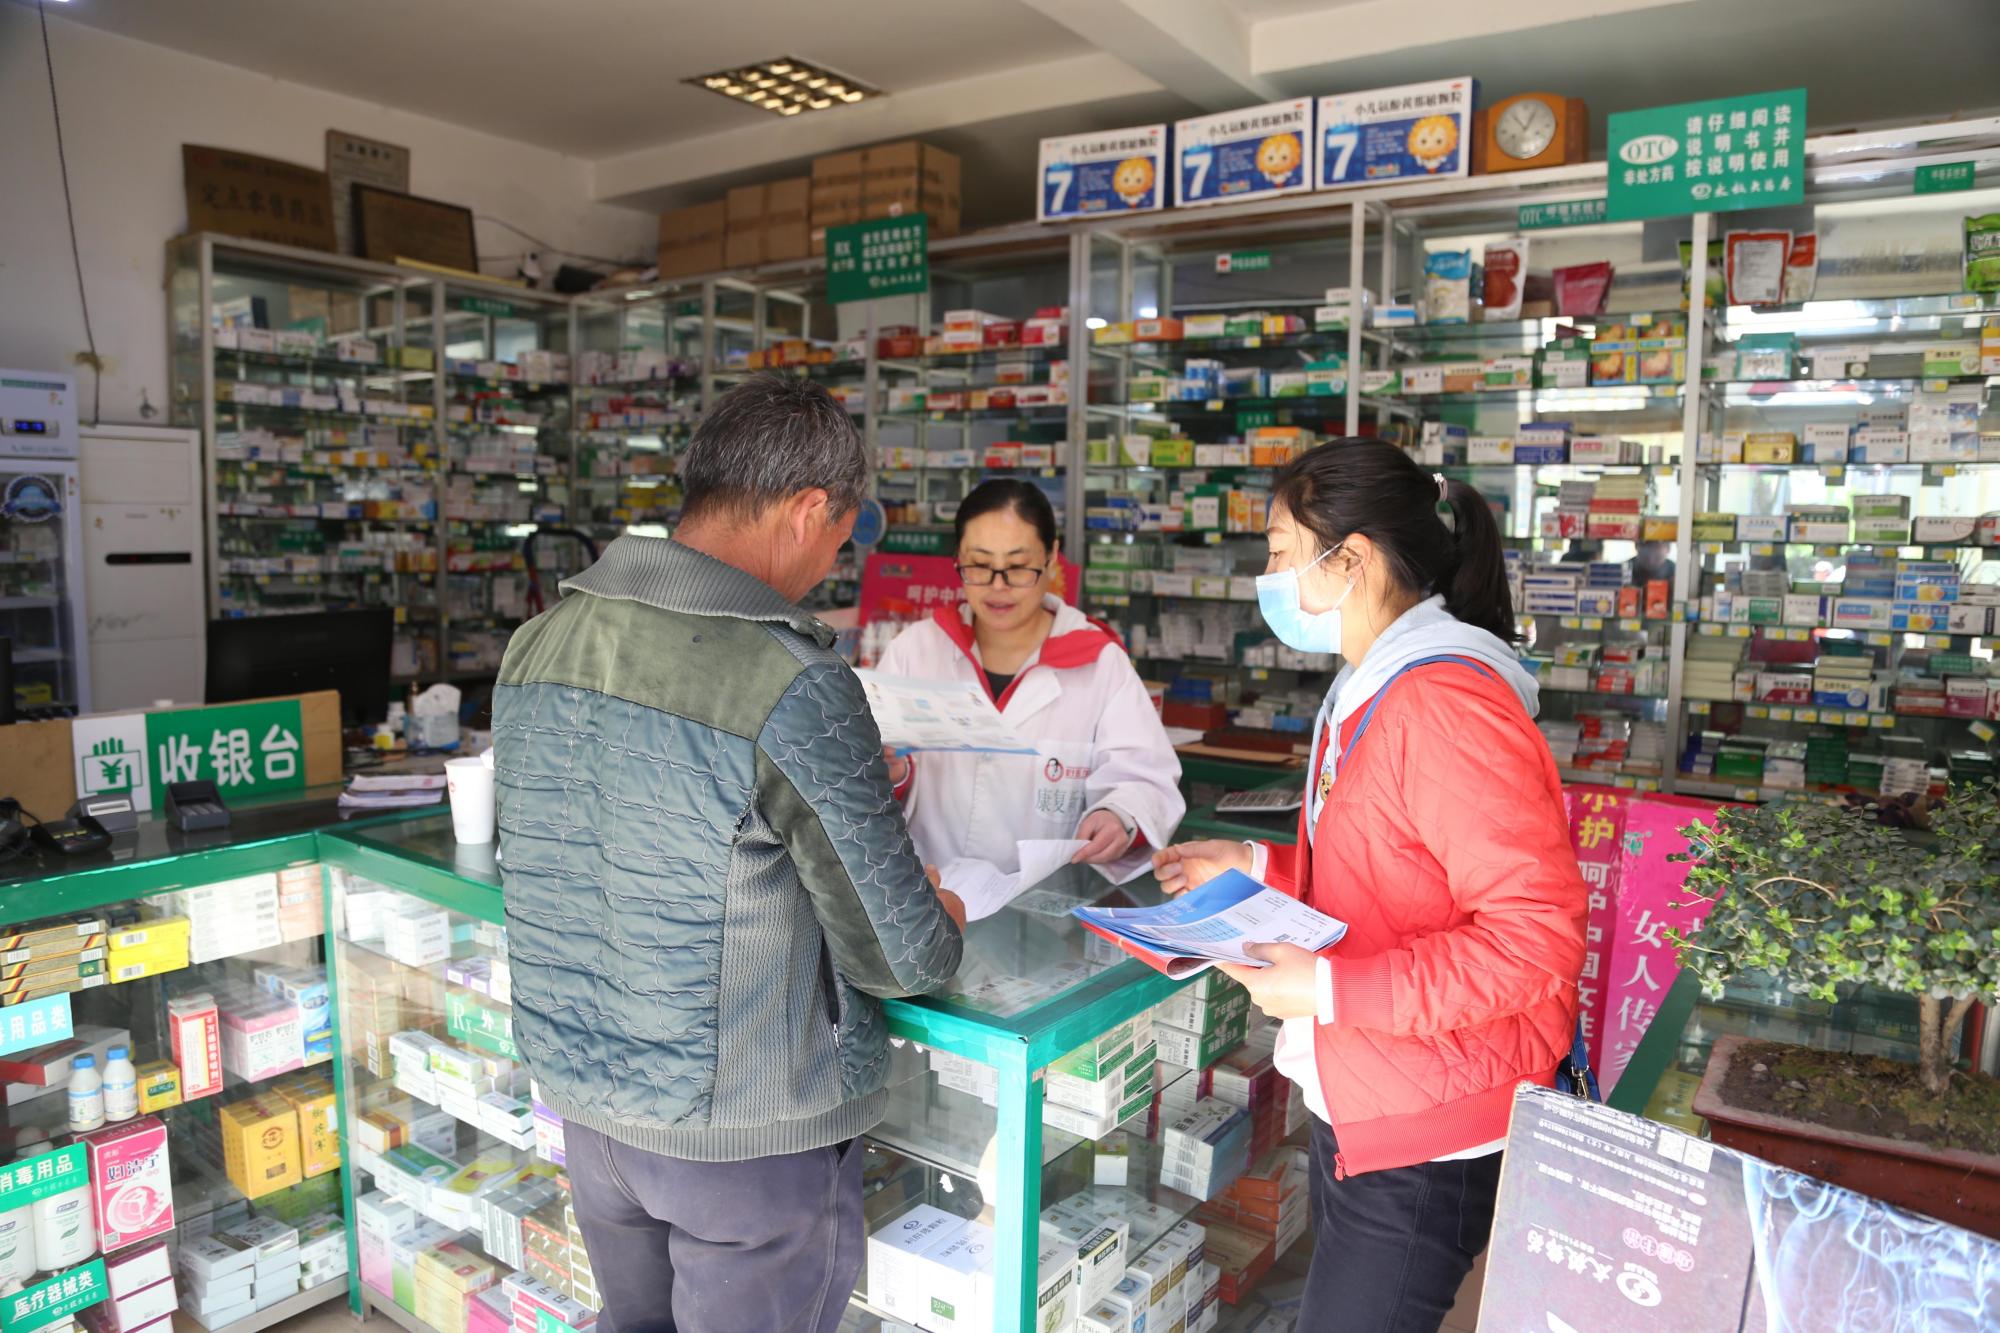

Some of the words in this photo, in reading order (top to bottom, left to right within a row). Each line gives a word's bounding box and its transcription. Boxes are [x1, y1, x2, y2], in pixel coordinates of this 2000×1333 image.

[1686, 104, 1791, 135] 请仔细阅读
[1327, 132, 1358, 181] 7
[1628, 139, 1674, 161] OTC
[1686, 127, 1790, 156] 说明书并
[1184, 152, 1212, 198] 7
[1624, 165, 1674, 186] 非处方药
[1685, 148, 1789, 178] 按说明使用
[1047, 170, 1073, 212] 7
[1520, 208, 1542, 225] OTC
[159, 724, 299, 786] 收银台
[0, 1005, 66, 1046] 用品类
[0, 1154, 73, 1193] 消毒用品
[14, 1270, 94, 1320] 医疗器械类
